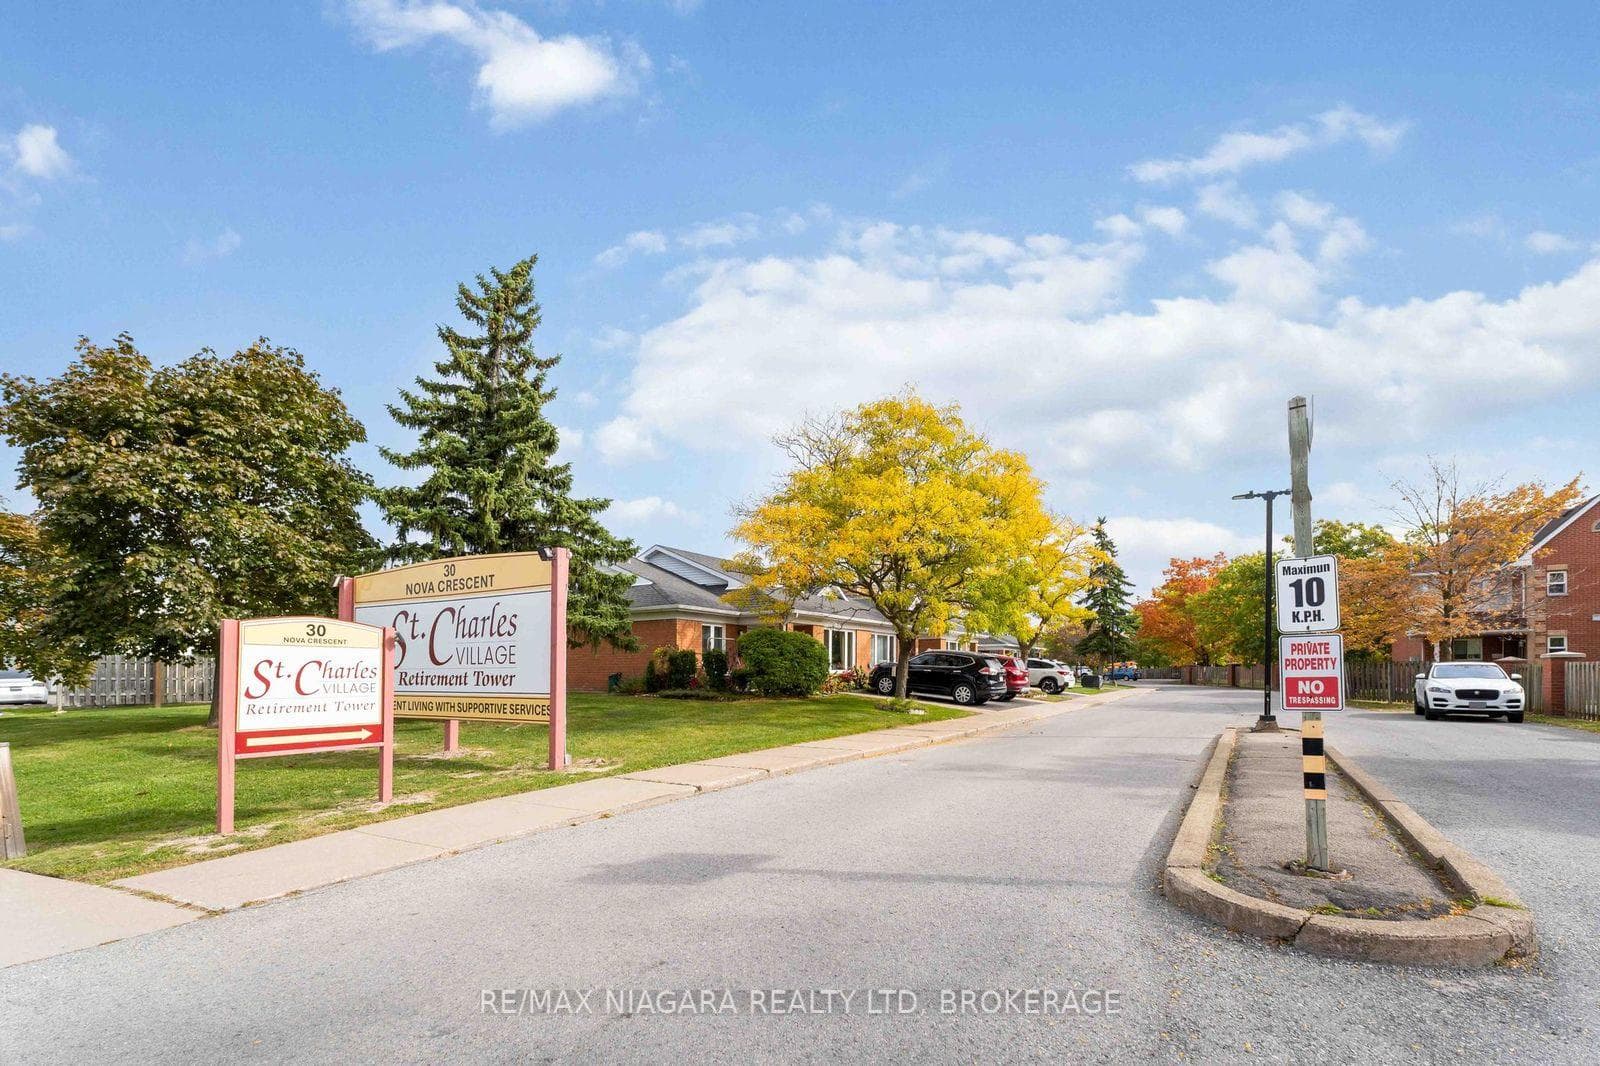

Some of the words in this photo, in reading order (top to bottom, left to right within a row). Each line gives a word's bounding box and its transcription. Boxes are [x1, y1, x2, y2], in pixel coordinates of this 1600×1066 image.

[443, 564, 456, 577] 30
[405, 581, 435, 595] NOVA
[437, 575, 495, 593] CRESCENT
[1289, 577, 1325, 607] 10
[1292, 610, 1325, 623] K.P.H.
[306, 624, 326, 637] 30
[392, 610, 426, 670] St.
[428, 602, 518, 666] Charles
[283, 637, 306, 645] NOVA
[307, 637, 347, 646] CRESCENT
[455, 645, 516, 665] VILLAGE
[1290, 642, 1330, 656] PRIVATE
[1284, 657, 1337, 671] PROPERTY
[244, 659, 291, 699] St.
[294, 659, 378, 696] Charles
[398, 671, 468, 687] Retirement
[473, 671, 516, 687] Tower
[322, 682, 376, 695] VILLAGE
[1298, 680, 1325, 694] NO
[1288, 696, 1336, 705] TRESPASSING
[246, 702, 328, 715] Retirement
[333, 701, 376, 712] Tower
[408, 701, 434, 712] LIVING
[435, 702, 455, 713] WITH
[457, 702, 507, 715] SUPPORTIVE
